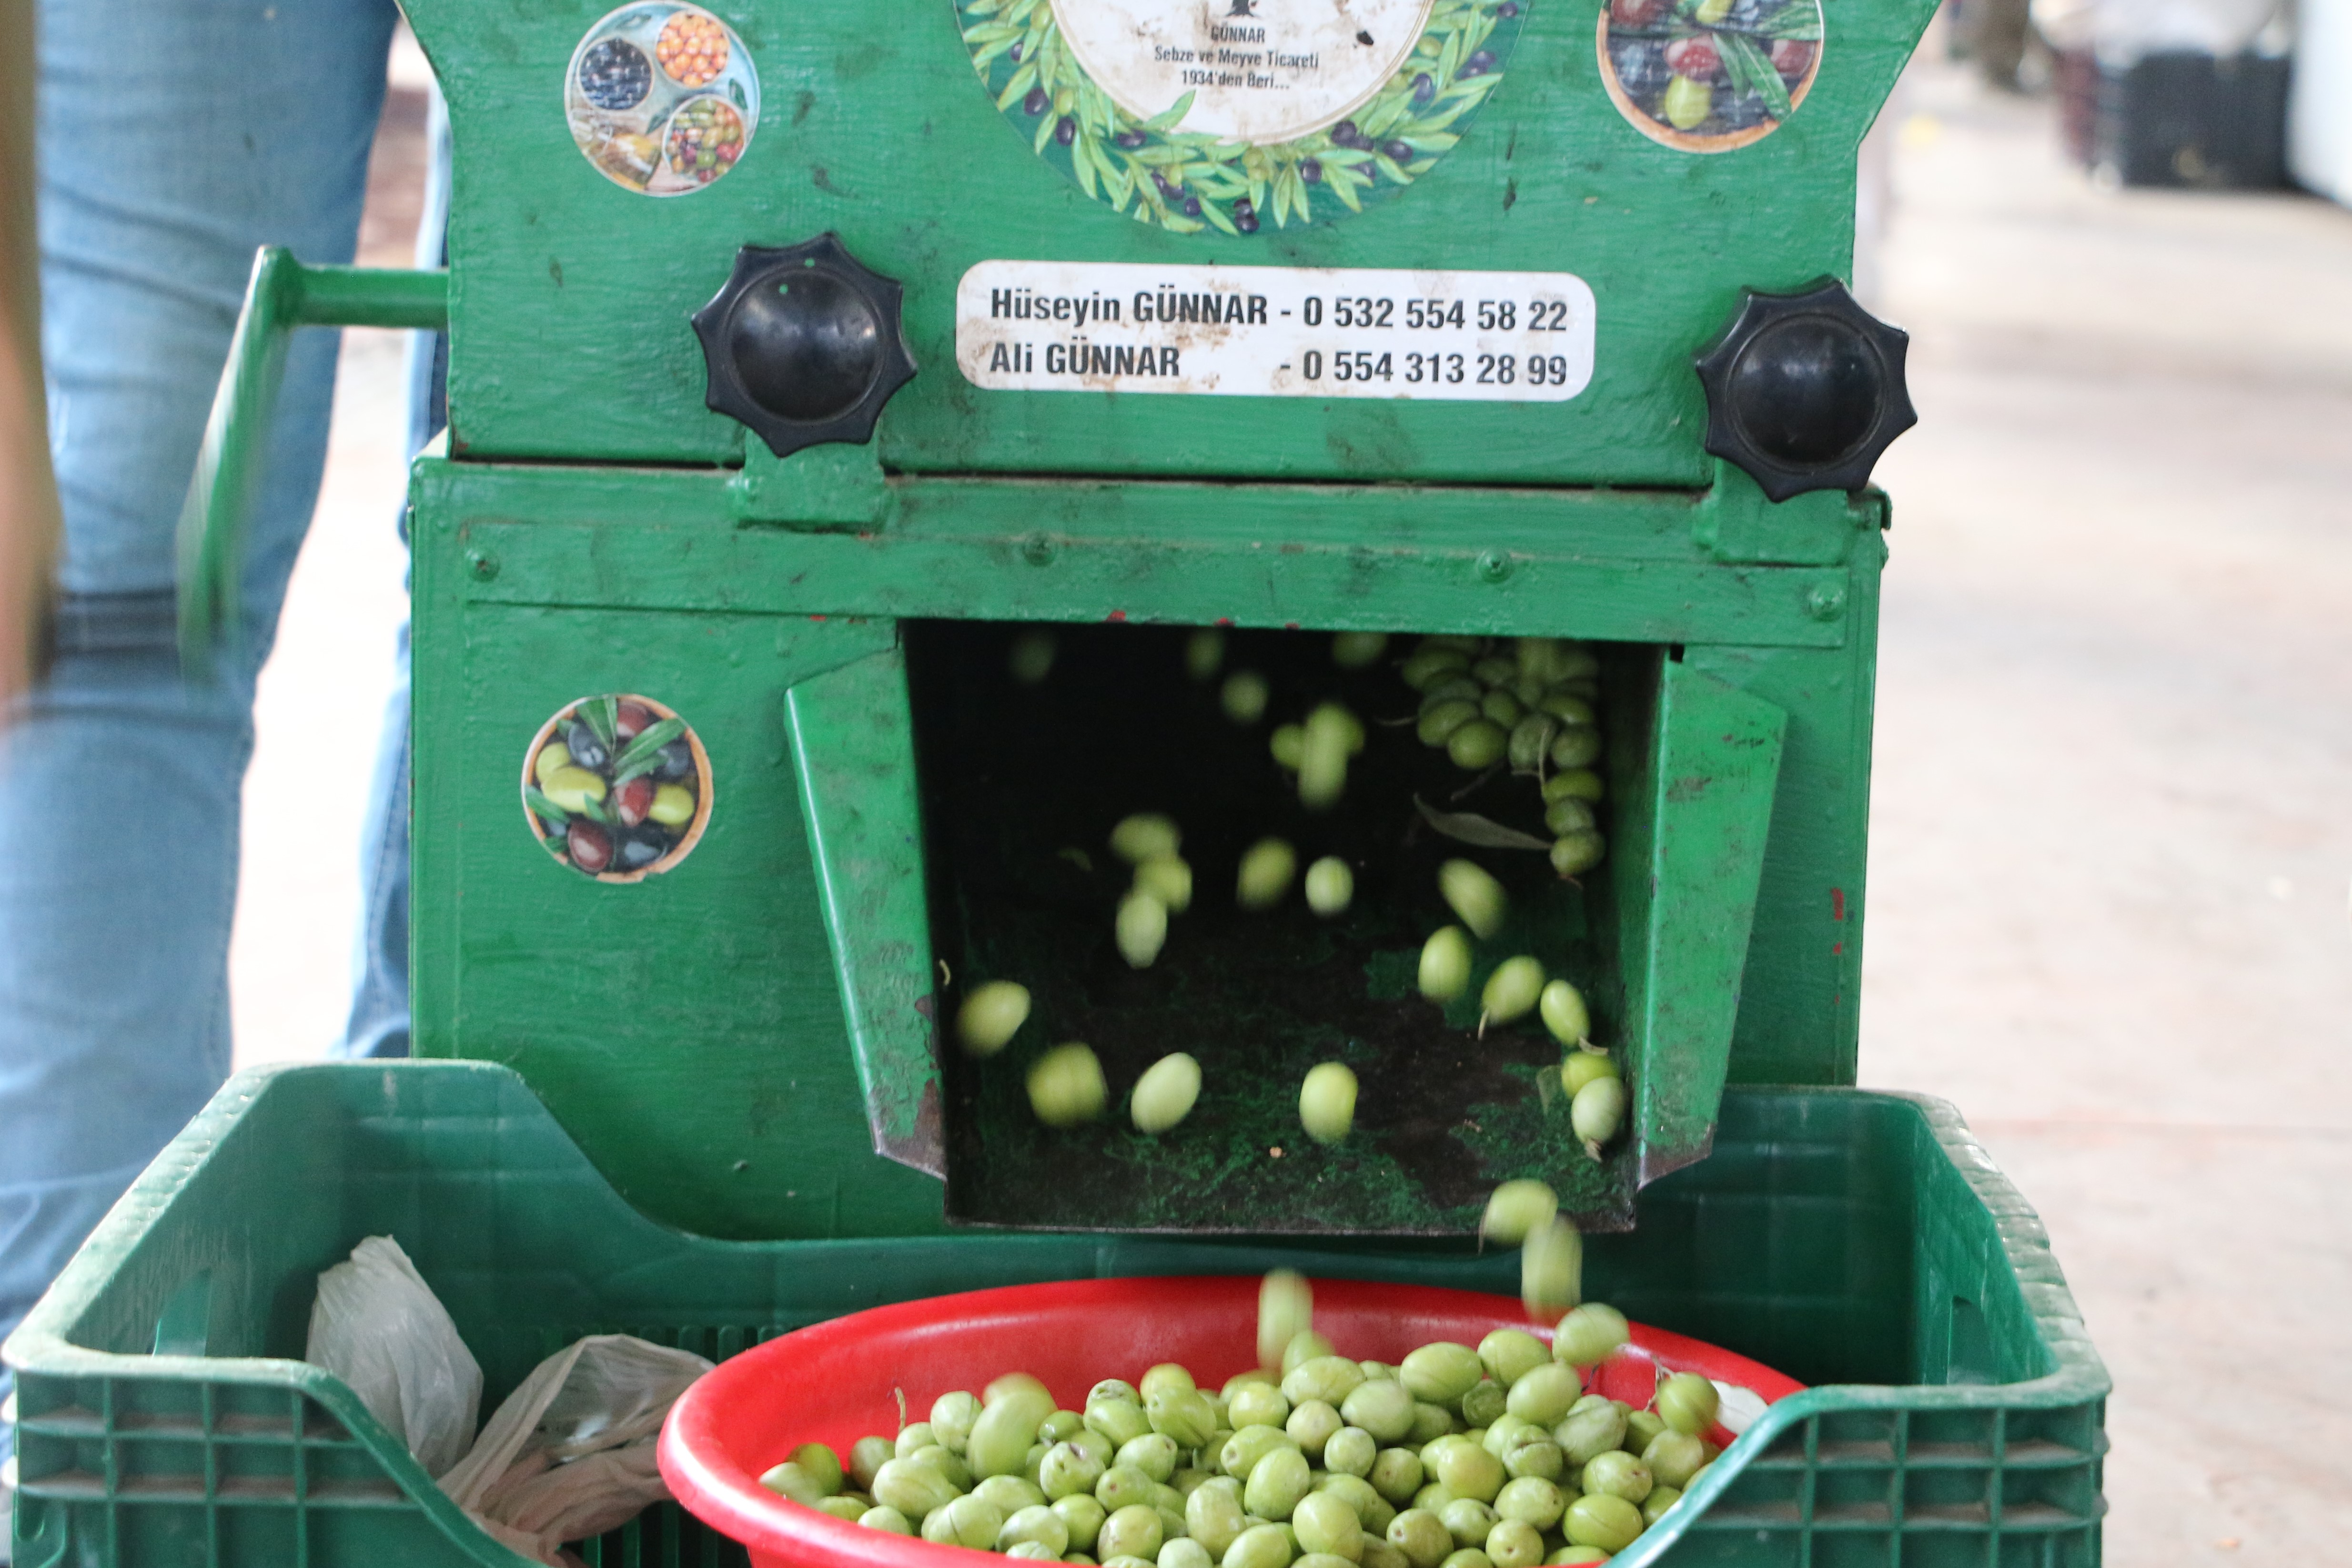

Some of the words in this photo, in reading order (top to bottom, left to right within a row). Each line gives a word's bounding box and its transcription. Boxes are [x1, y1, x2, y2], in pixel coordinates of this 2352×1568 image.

[1211, 22, 1265, 42] GÜNNAR
[1155, 46, 1193, 62] Sebze
[1199, 50, 1213, 62] ve
[1219, 49, 1262, 67] Meyve
[1267, 50, 1318, 68] Ticareti
[991, 288, 1120, 327] Hüseyin
[1134, 283, 1267, 324] GÜNNAR
[1303, 296, 1322, 326] 0
[1335, 297, 1393, 327] 532
[1406, 298, 1465, 329] 554
[1478, 300, 1516, 330] 58
[1528, 300, 1567, 331] 22
[990, 342, 1032, 372] Ali
[1046, 336, 1180, 376] GÜNNAR
[1303, 350, 1322, 380] 0
[1334, 351, 1393, 381] 554
[1405, 352, 1464, 382] 313
[1476, 354, 1515, 384] 28
[1528, 354, 1566, 385] 99
